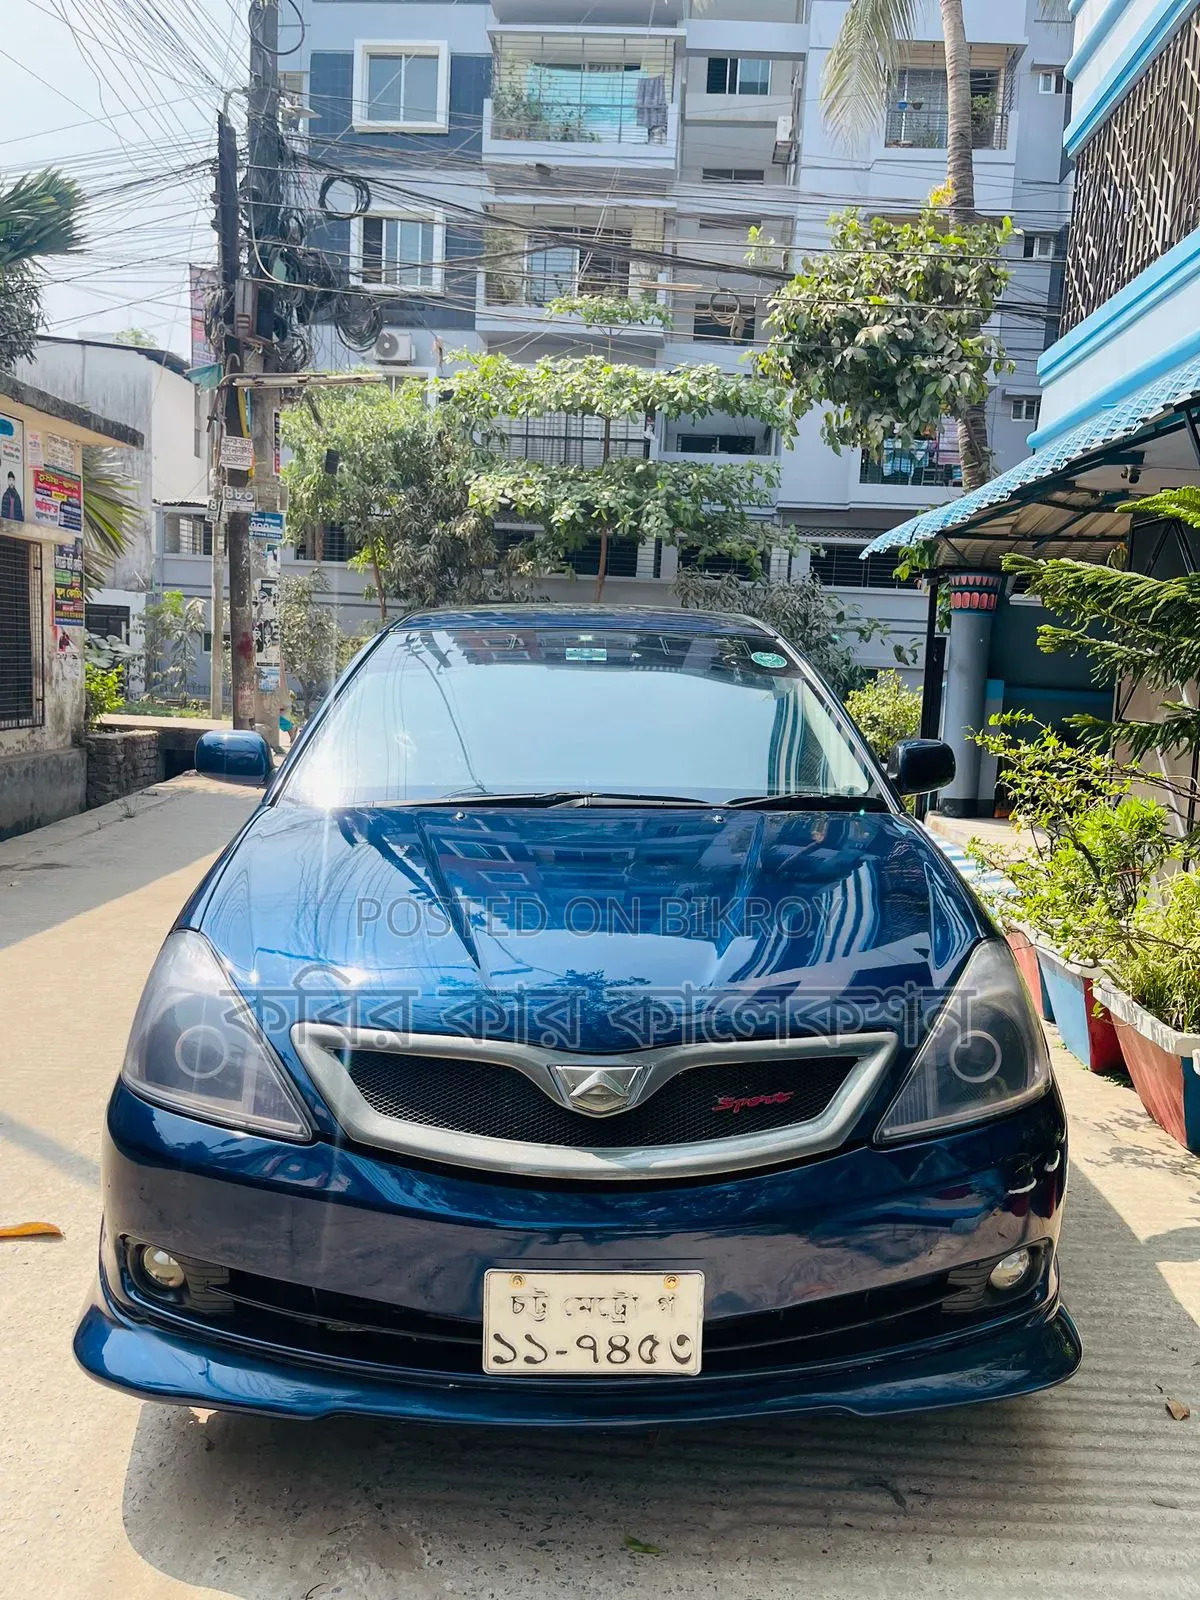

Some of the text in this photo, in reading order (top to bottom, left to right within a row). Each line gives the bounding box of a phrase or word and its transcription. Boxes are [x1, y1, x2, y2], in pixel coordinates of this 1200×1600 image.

[712, 1091, 795, 1113] Sport
[656, 1294, 676, 1318] গ
[492, 1333, 694, 1365] ১১-৭৪৫৩
